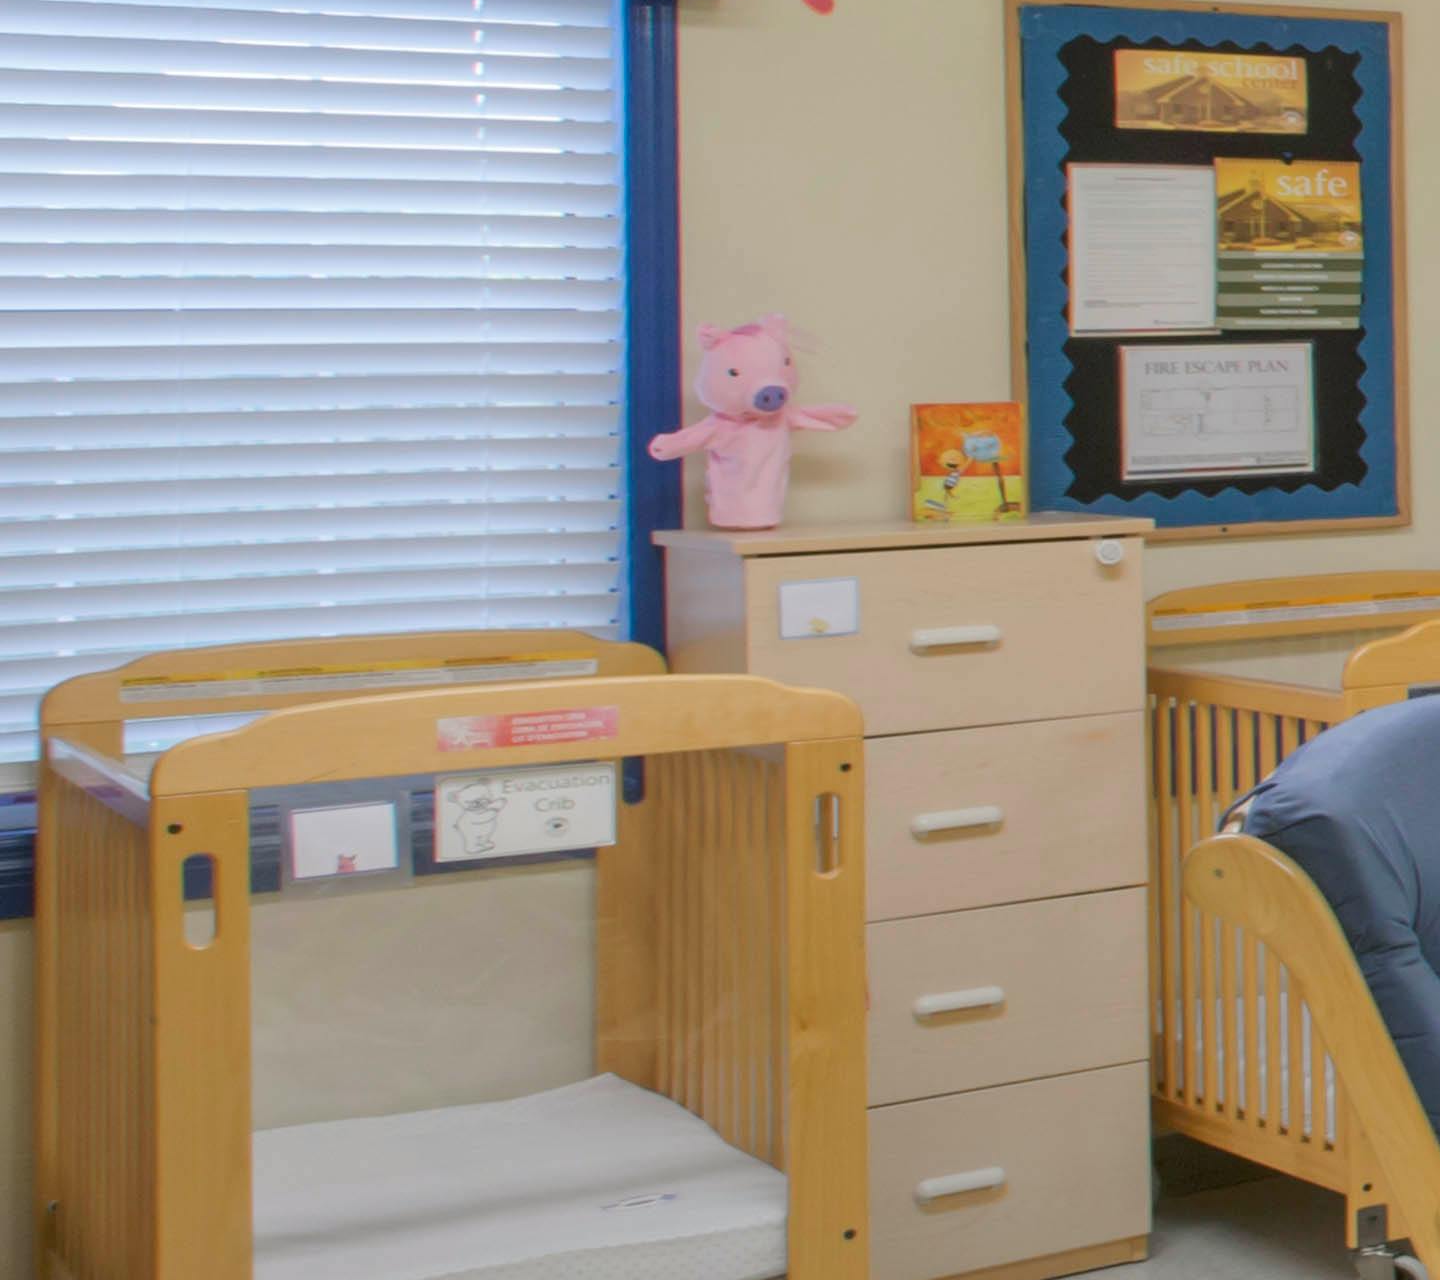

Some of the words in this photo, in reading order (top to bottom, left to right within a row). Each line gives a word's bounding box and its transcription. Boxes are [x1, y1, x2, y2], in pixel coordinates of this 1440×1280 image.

[1142, 53, 1199, 76] safe
[1208, 56, 1299, 81] school
[1276, 168, 1348, 198] safe
[1144, 360, 1180, 376] FIRE
[1184, 359, 1244, 375] ESCAPE
[1247, 358, 1290, 374] PLAN
[502, 774, 611, 795] Evacuation
[533, 797, 577, 813] Crib
